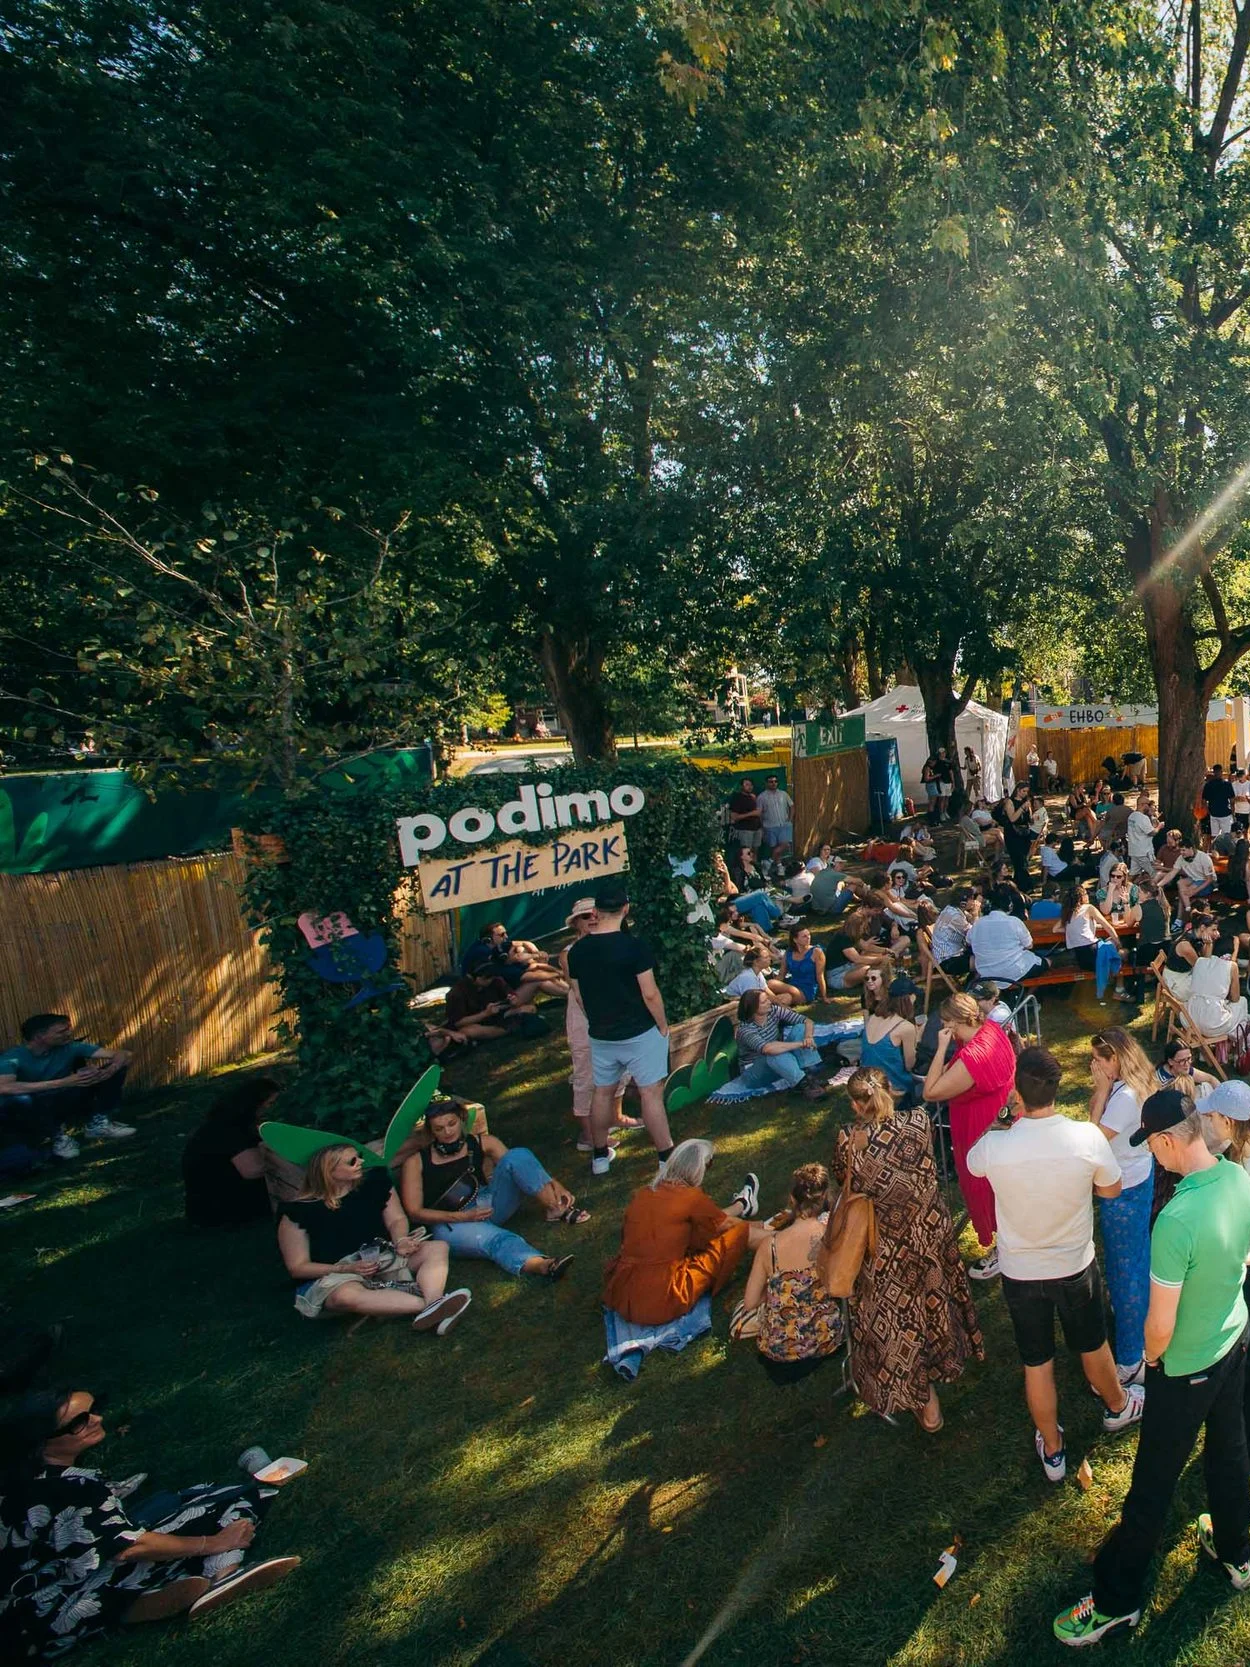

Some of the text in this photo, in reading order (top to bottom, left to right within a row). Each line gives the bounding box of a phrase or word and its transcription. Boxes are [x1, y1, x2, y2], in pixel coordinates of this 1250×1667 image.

[1069, 709, 1104, 723] EHBO
[396, 783, 645, 867] podimo
[430, 860, 476, 898] AT
[480, 850, 541, 888] THE
[551, 835, 620, 877] PARK
